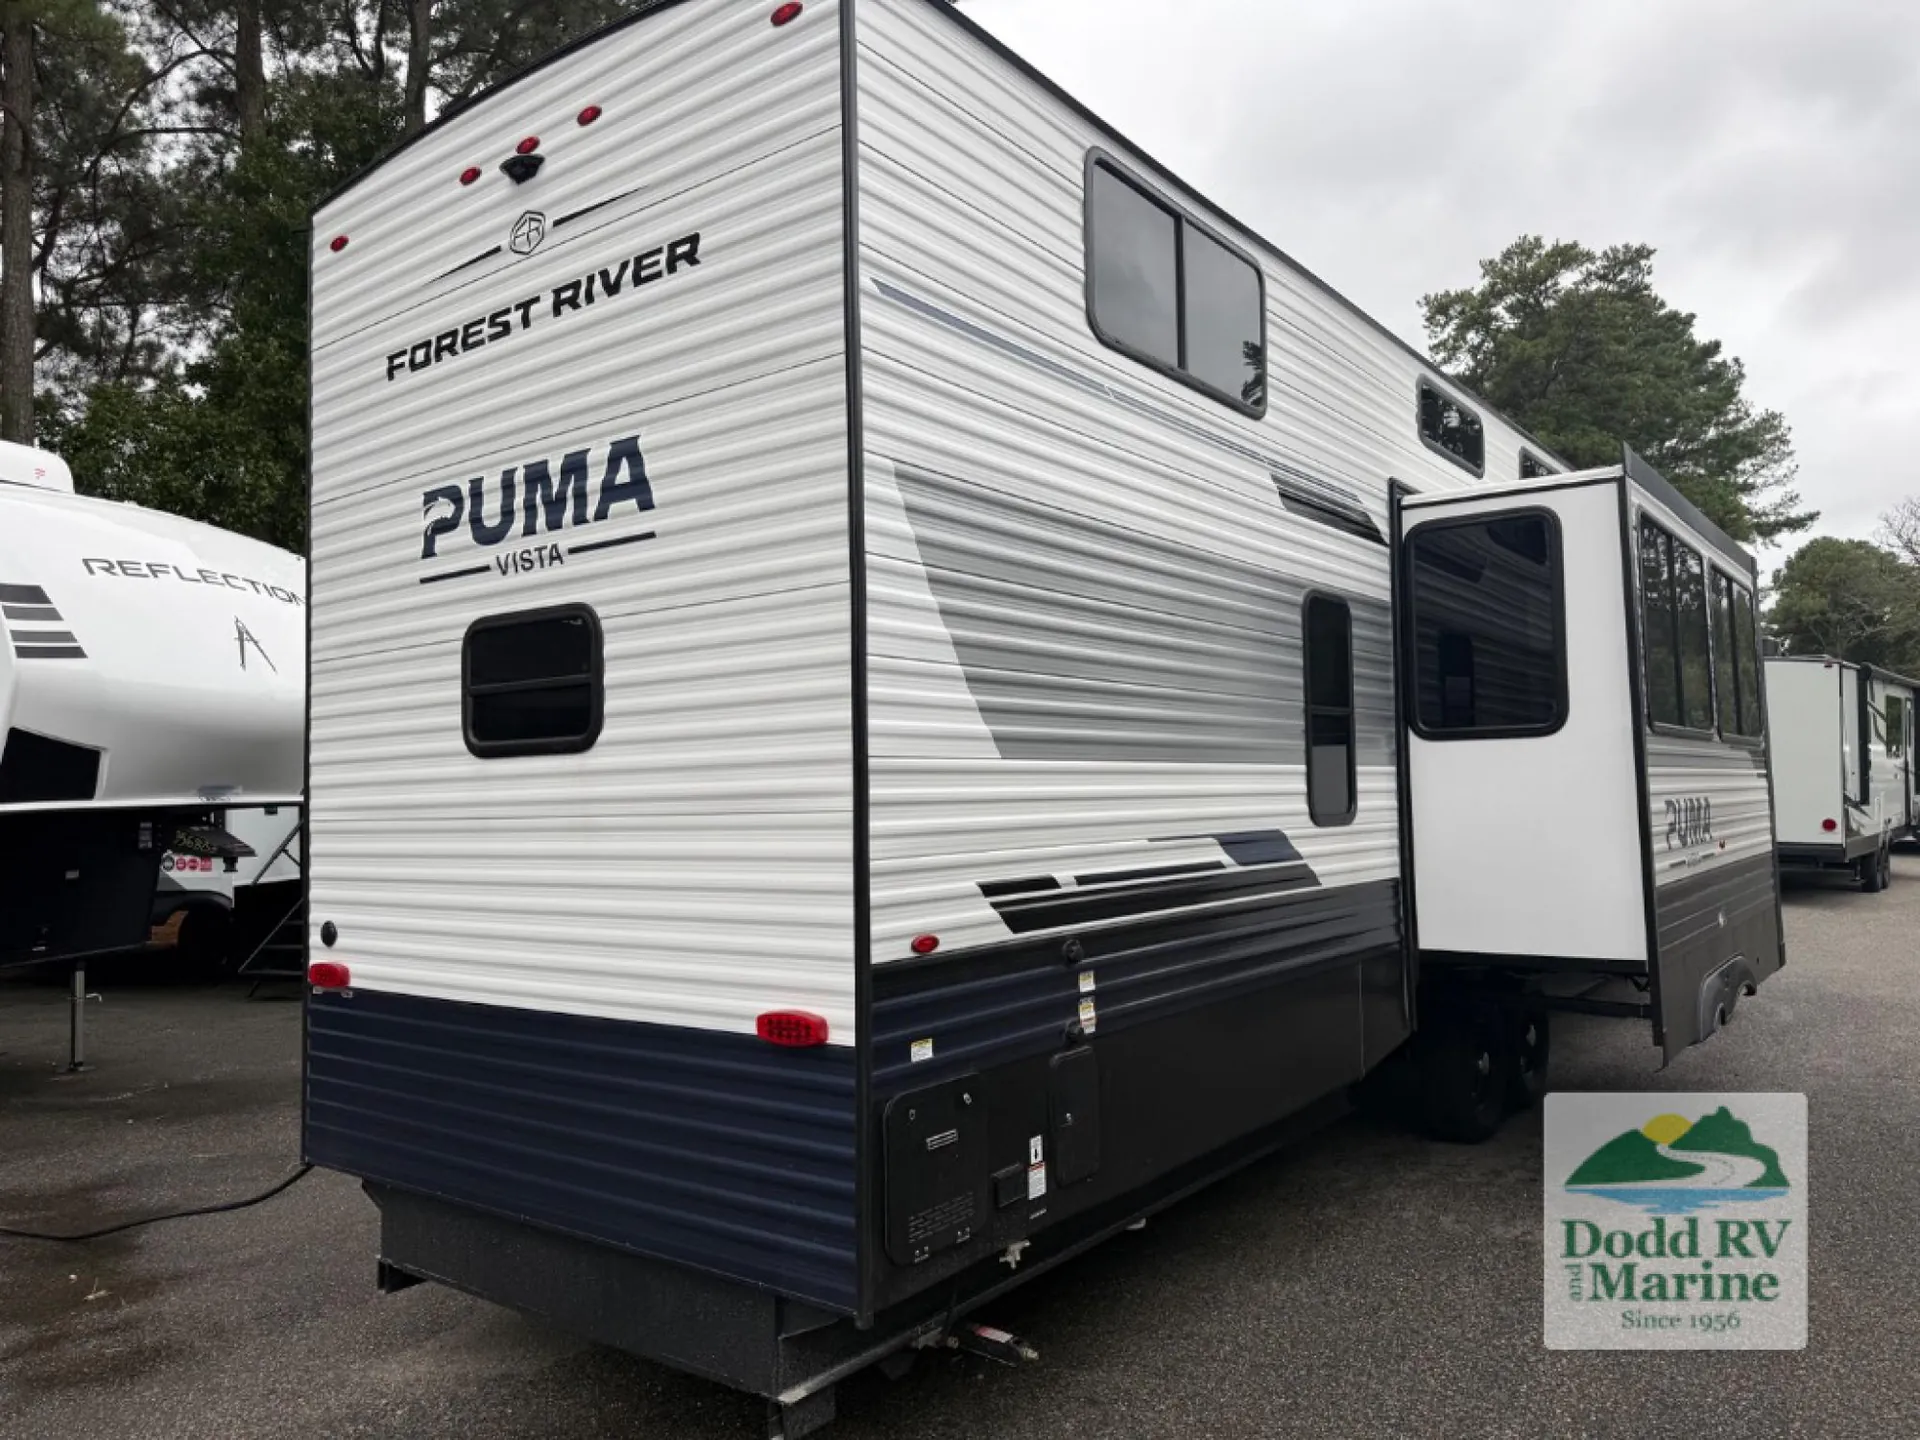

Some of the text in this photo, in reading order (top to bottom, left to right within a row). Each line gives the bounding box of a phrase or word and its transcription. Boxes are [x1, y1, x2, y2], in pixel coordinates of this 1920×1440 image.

[386, 231, 701, 381] FOREST RIVER
[421, 434, 656, 560] PUMA
[496, 543, 564, 576] VISTA
